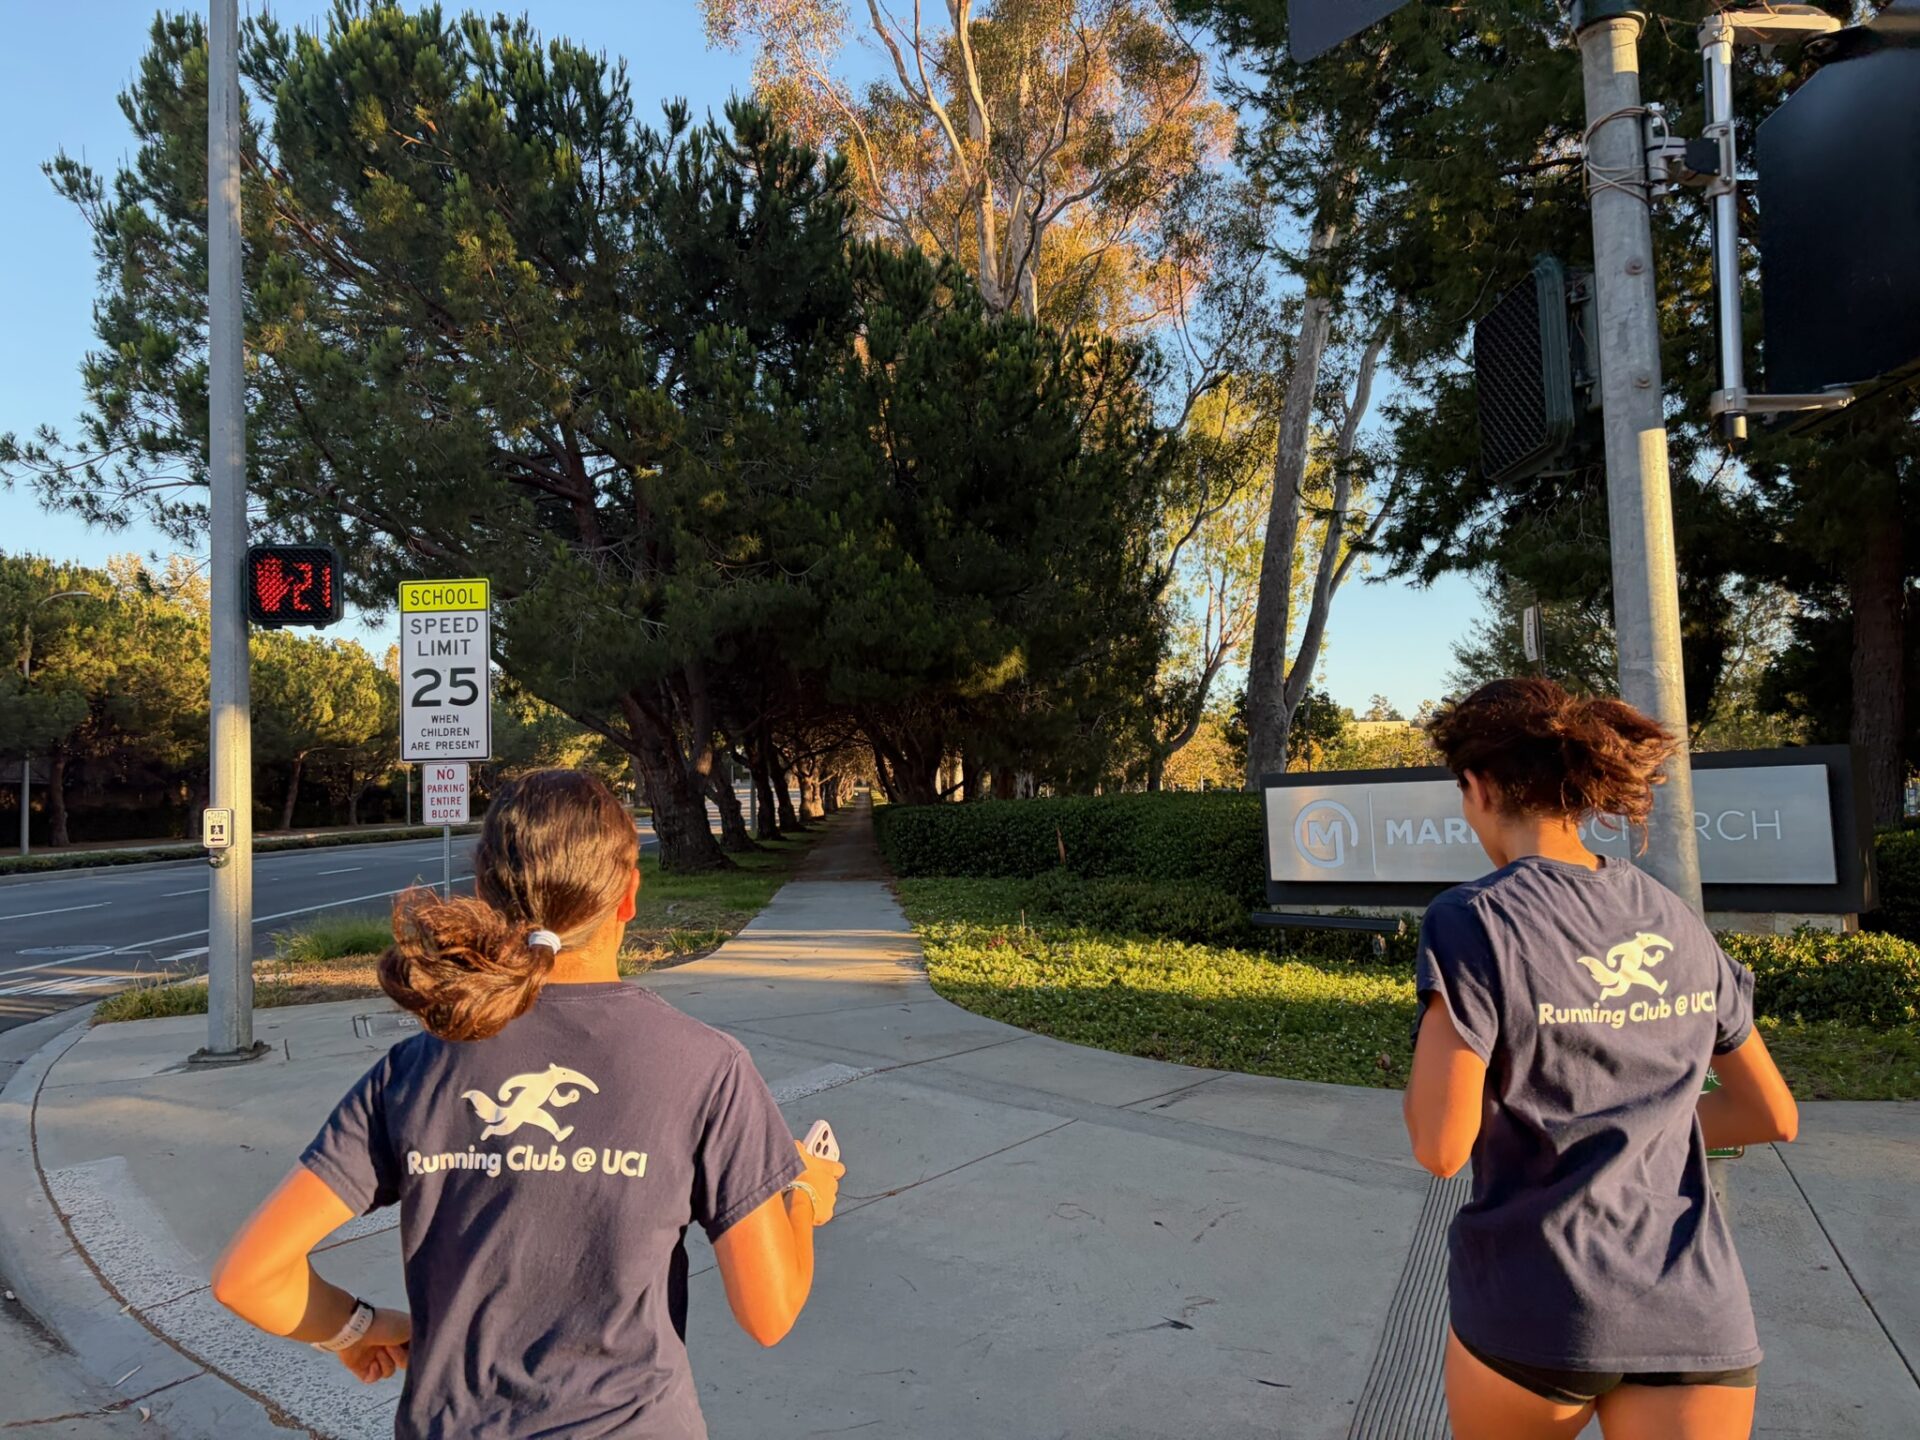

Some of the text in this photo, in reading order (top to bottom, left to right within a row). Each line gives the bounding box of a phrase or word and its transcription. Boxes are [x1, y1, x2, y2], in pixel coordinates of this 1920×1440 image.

[292, 562, 331, 611] 21
[410, 588, 479, 606] SCHOOL
[410, 616, 479, 635] SPEED
[418, 638, 471, 656] LIMIT
[411, 667, 479, 707] 25
[431, 714, 460, 724] WHEN
[421, 727, 470, 737] CHILDREN
[410, 740, 480, 751] ARE PRESENT
[437, 768, 455, 780] NO
[427, 784, 465, 793] PARKING
[430, 796, 462, 806] ENTIRE
[432, 809, 461, 819] BLOCK
[1590, 809, 1782, 842] CRCH
[1538, 989, 1717, 1030] Running Club @ UCI
[407, 1145, 648, 1178] Running Club @ UCI
